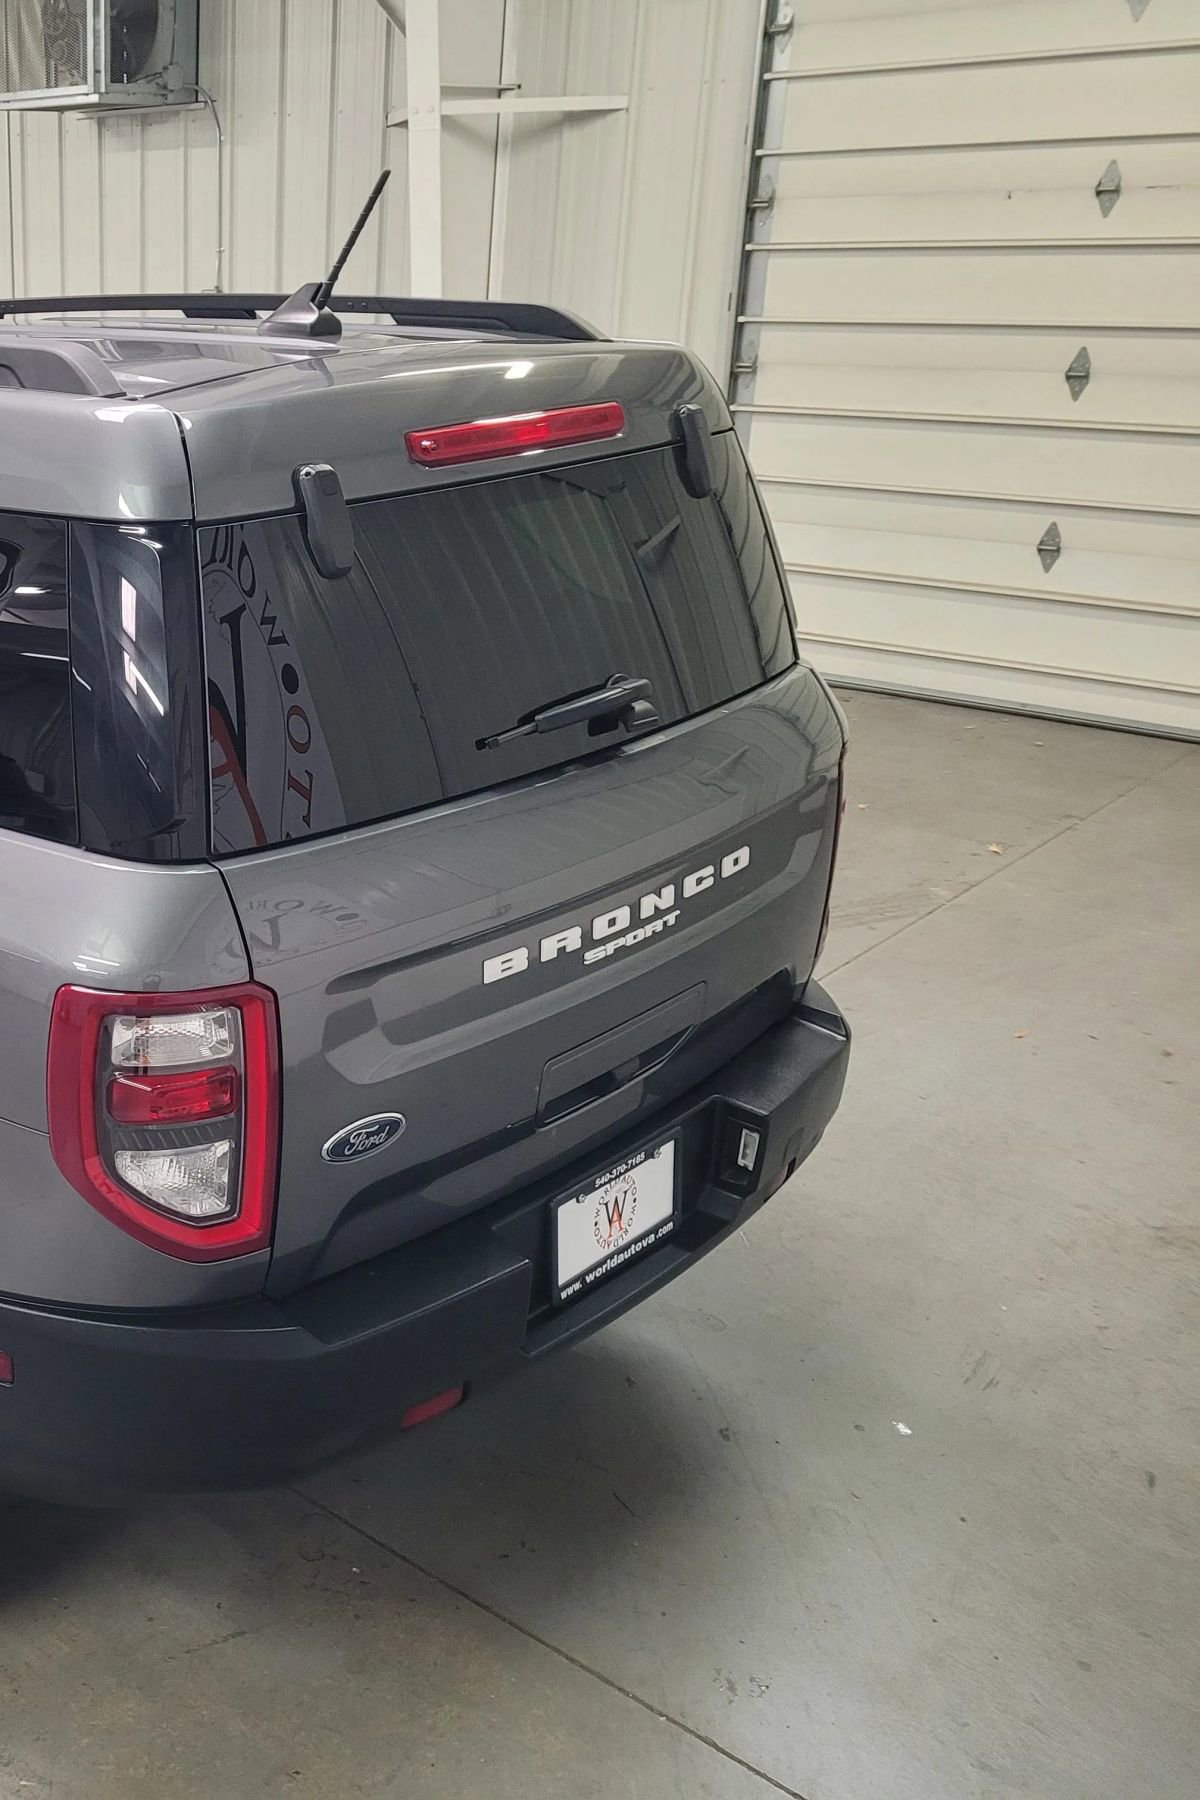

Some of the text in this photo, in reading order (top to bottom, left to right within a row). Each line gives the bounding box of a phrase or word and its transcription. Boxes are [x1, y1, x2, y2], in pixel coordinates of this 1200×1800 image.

[483, 845, 750, 985] BRONCO
[583, 910, 681, 966] SPORT
[344, 1124, 390, 1156] Ford
